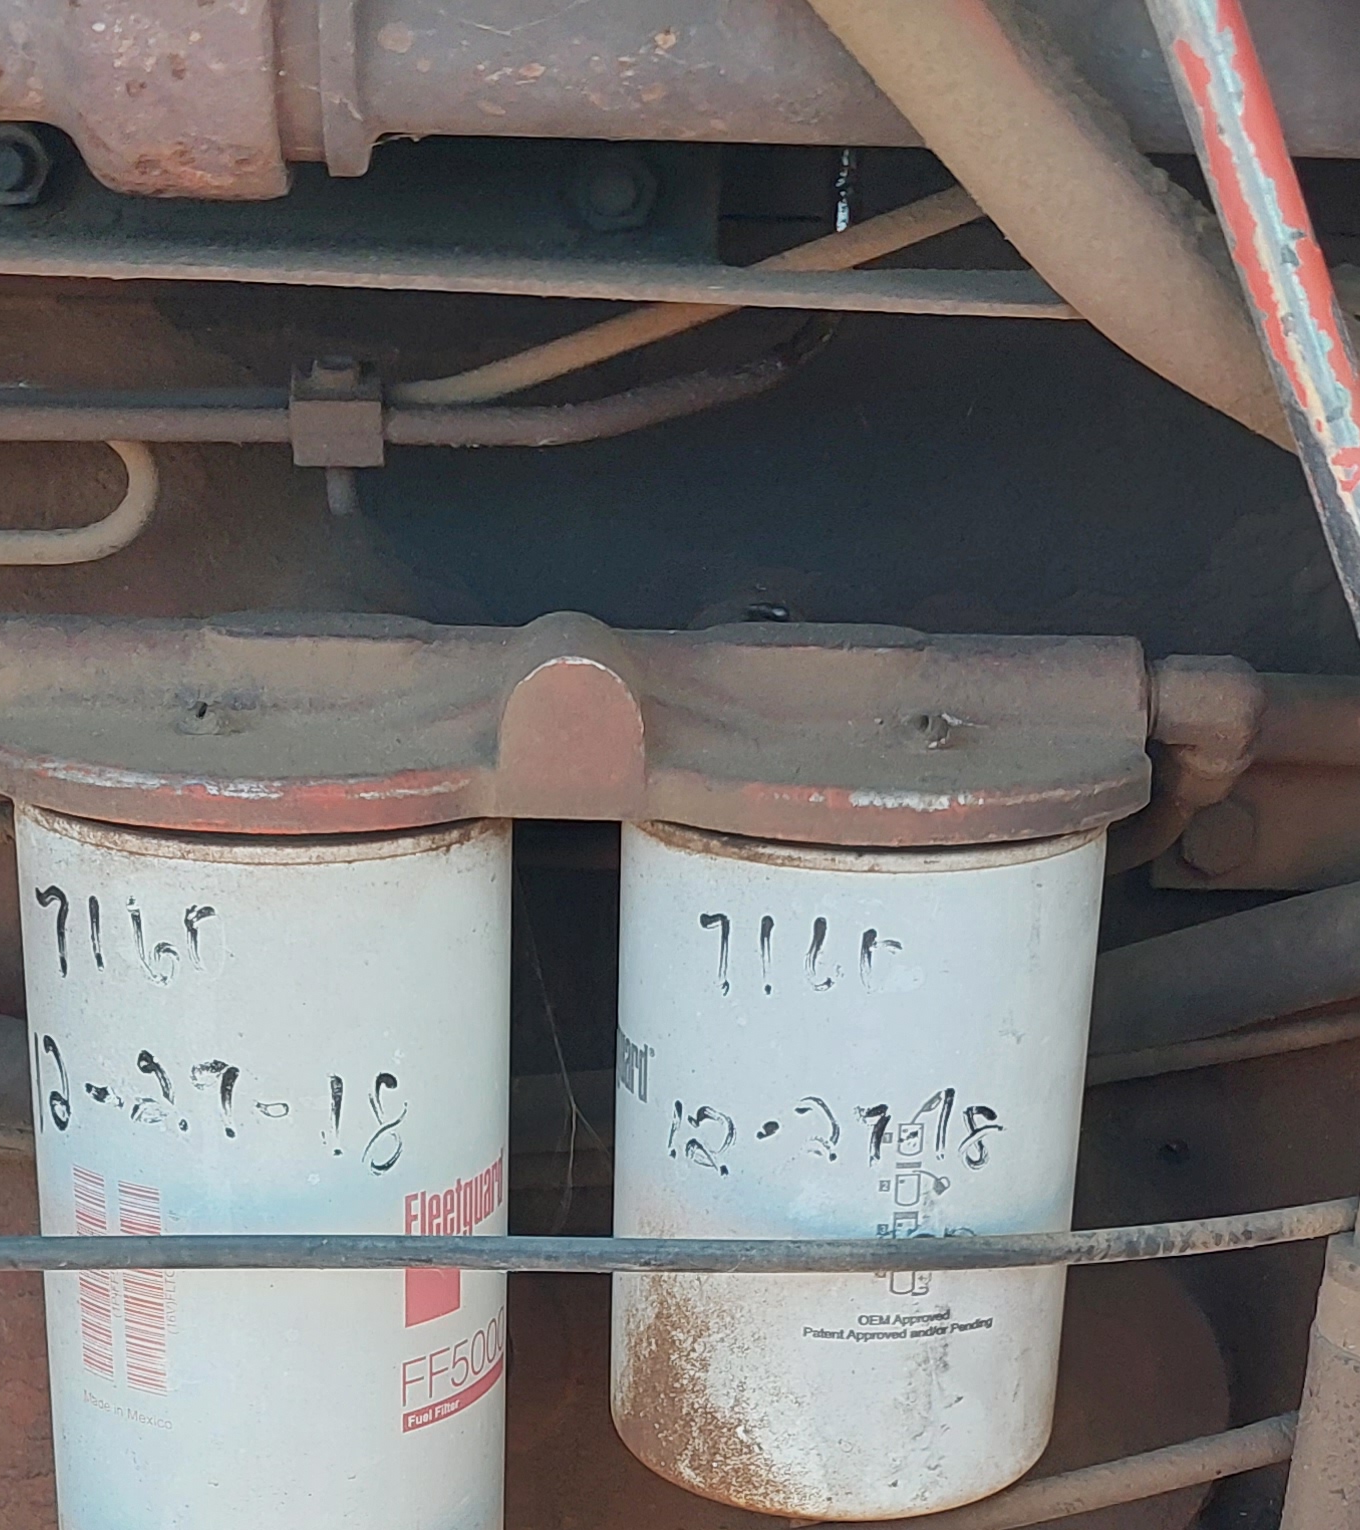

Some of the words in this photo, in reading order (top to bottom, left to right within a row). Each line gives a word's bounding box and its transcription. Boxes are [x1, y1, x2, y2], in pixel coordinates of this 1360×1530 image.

[405, 1146, 504, 1236] Fleetguard
[803, 1326, 845, 1340] Patent
[846, 1328, 907, 1342] Approved
[909, 1325, 948, 1338] and/or
[949, 1317, 994, 1334] Pending
[857, 1314, 890, 1326] OEM
[892, 1309, 951, 1327] Approved
[83, 1389, 111, 1412] Made
[113, 1406, 124, 1417] in
[127, 1408, 173, 1430] Mexico
[407, 1408, 433, 1428] Fuel
[435, 1400, 460, 1419] Filter
